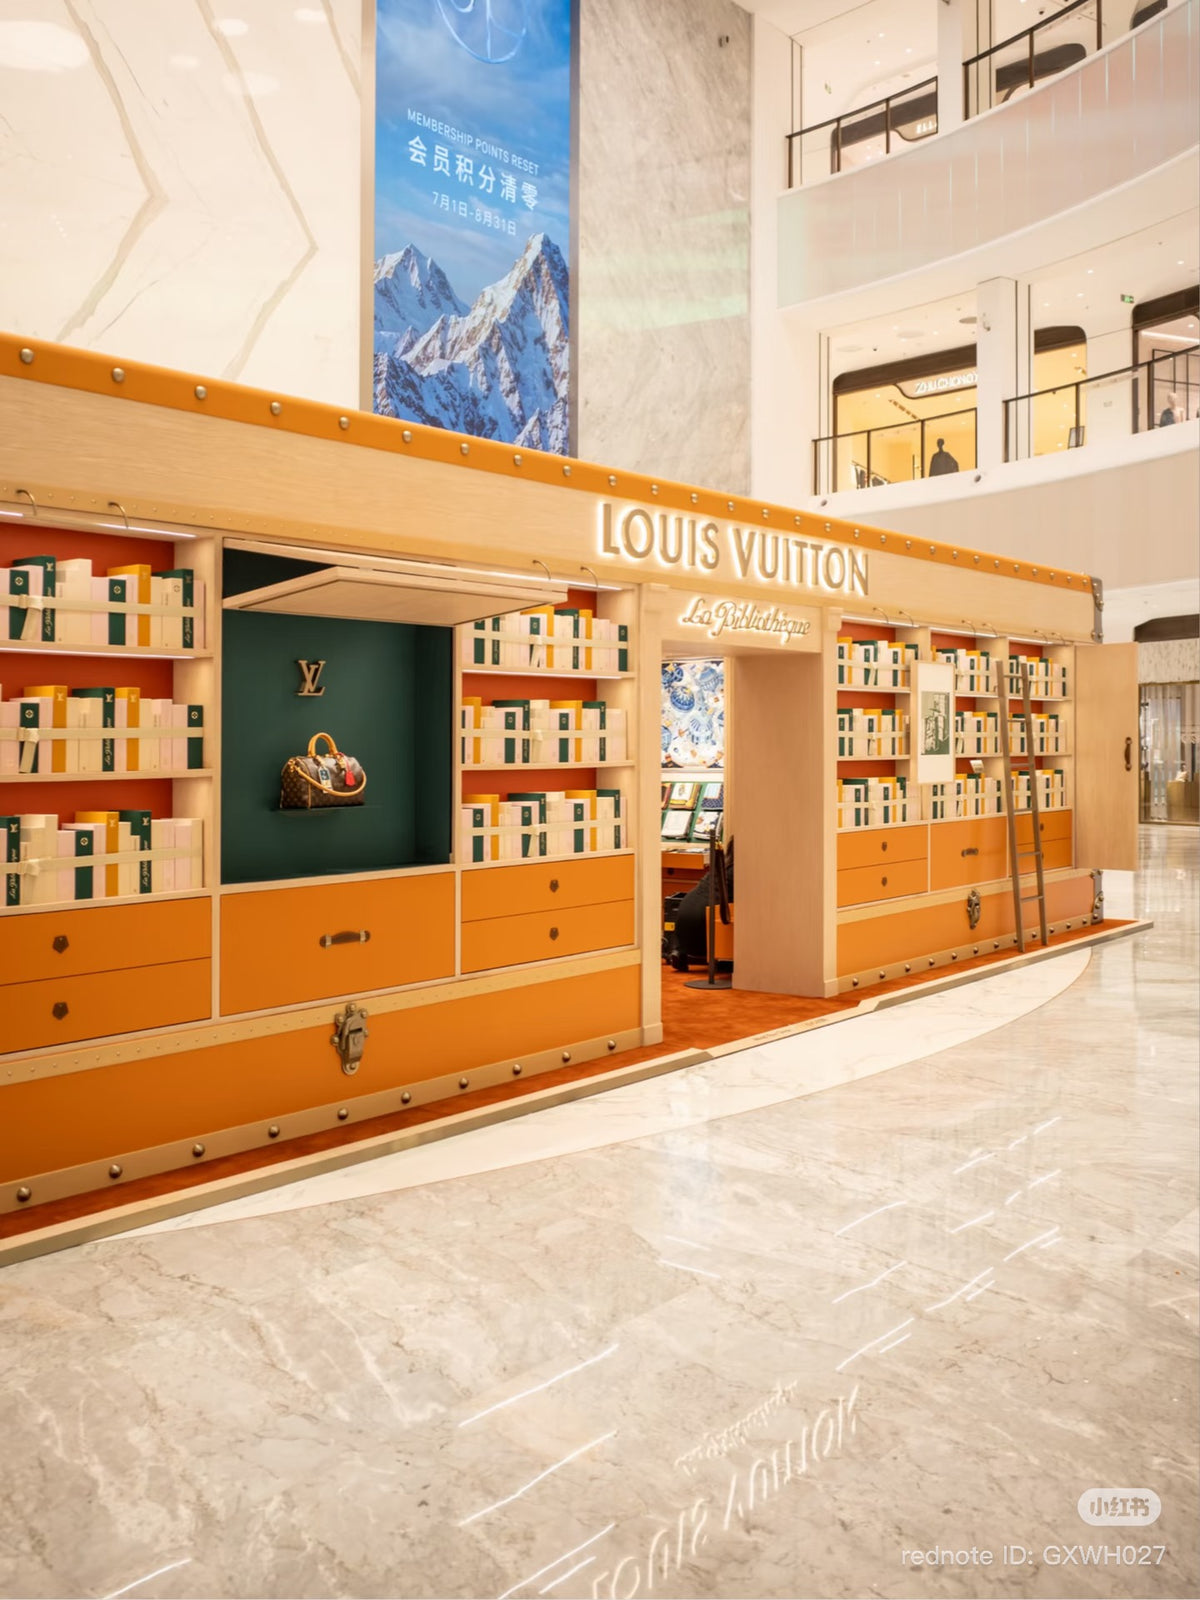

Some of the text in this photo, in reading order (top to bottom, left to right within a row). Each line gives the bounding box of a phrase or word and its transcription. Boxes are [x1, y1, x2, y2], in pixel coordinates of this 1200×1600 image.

[407, 107, 539, 176] MEMBERSHIP POINTS RESET
[408, 135, 538, 211] 会员积分清零
[432, 191, 516, 236] 7月1日-8月31日
[601, 502, 868, 596] LOUIS VUITTON
[681, 597, 713, 625] La
[298, 660, 327, 696] LV
